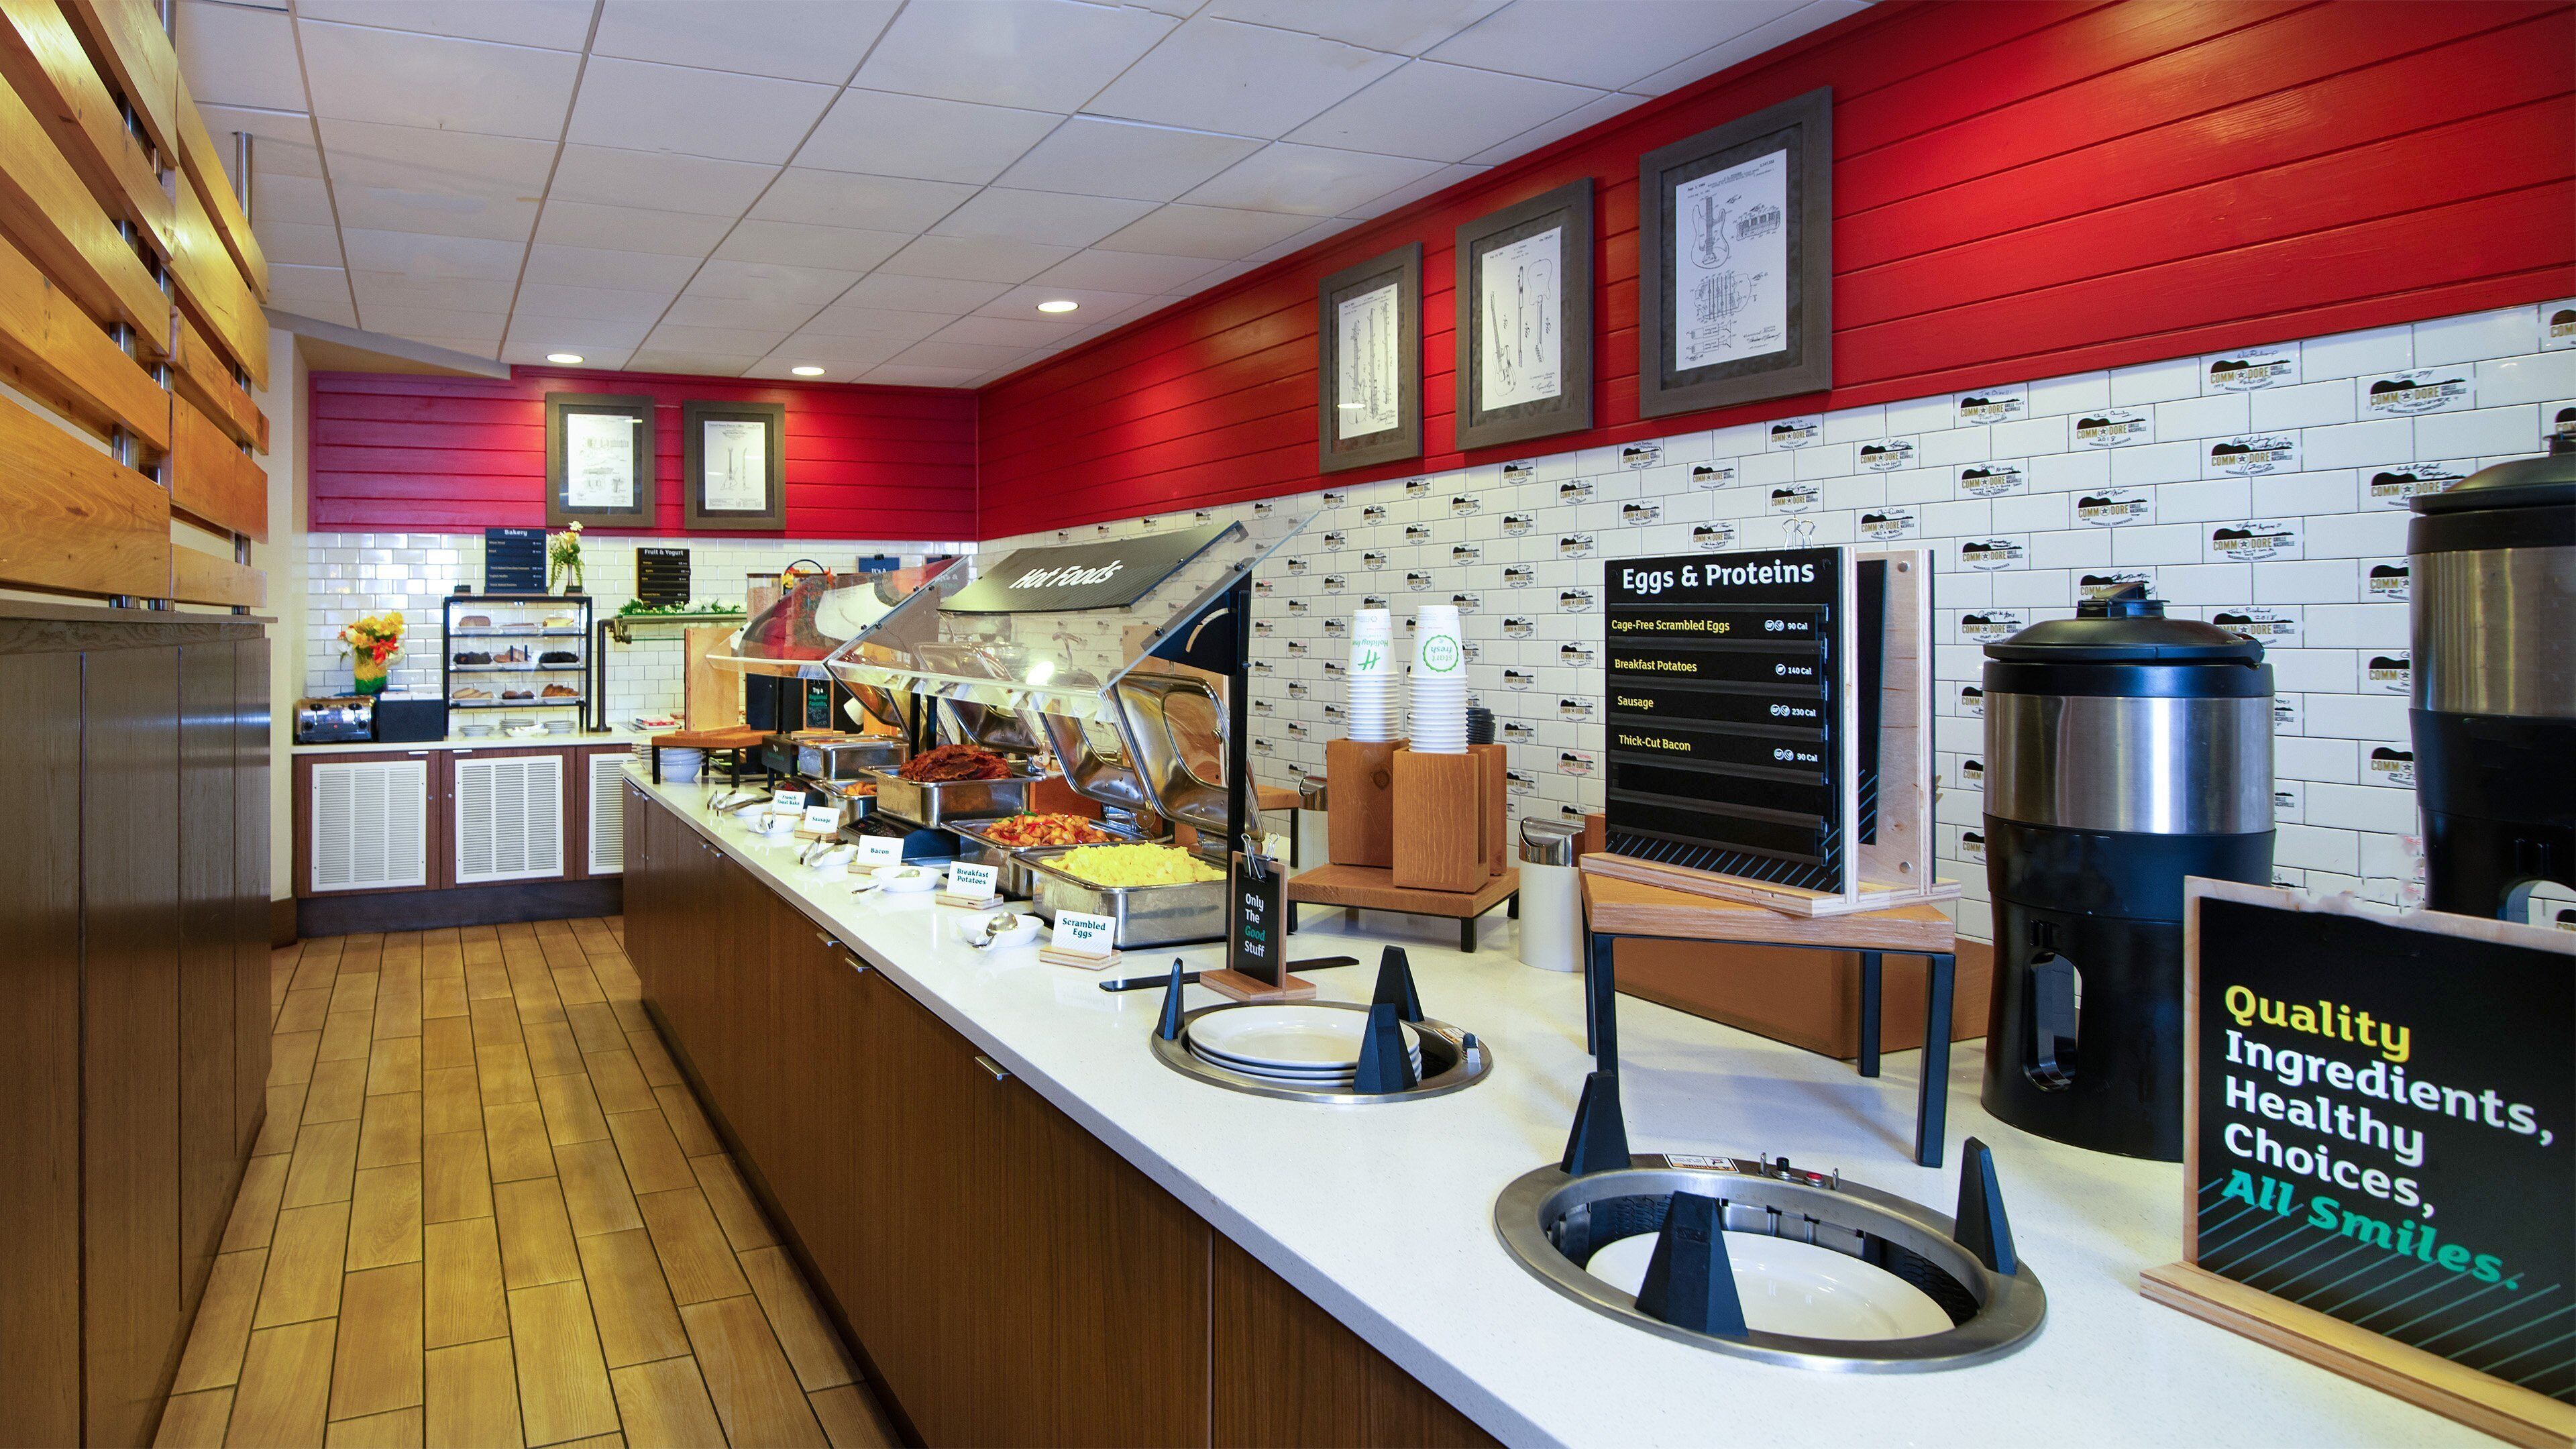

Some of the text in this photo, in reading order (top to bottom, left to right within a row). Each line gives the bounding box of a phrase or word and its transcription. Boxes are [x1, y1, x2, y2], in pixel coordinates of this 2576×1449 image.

[1008, 559, 1124, 589] Hot Foods
[1623, 559, 1815, 595] Eggs & Proteins
[1611, 619, 1654, 631] Cage-Free
[1656, 620, 1705, 631] Scrambled
[1707, 621, 1730, 634] Eggs
[1787, 622, 1796, 630] 90
[1797, 622, 1808, 631] Cal
[1361, 639, 1389, 647] Holiday
[1431, 646, 1452, 654] fresh
[1615, 659, 1656, 670] Breakfast
[1657, 661, 1697, 673] Potatoes
[1801, 667, 1812, 676] Cal
[1617, 696, 1654, 710] Sausage
[1805, 708, 1816, 716] Cal
[1619, 734, 1662, 749] Thick-Cut
[1663, 739, 1691, 751] Bacon
[1807, 753, 1818, 763] Cal
[957, 867, 989, 878] Breakfast
[957, 875, 986, 885] Potatoes
[1245, 893, 1265, 912] Only
[1062, 918, 1106, 930] Scrambled
[1245, 908, 1260, 924] The
[1073, 928, 1092, 938] Eggs
[1244, 925, 1266, 941] Good
[1244, 940, 1265, 958] Stuff
[2224, 984, 2411, 1063] Quality
[2224, 1028, 2554, 1147] Ingredients,
[2225, 1075, 2425, 1167] Healthy
[2224, 1122, 2436, 1218] Choices,
[2221, 1168, 2519, 1290] All Smiles.
